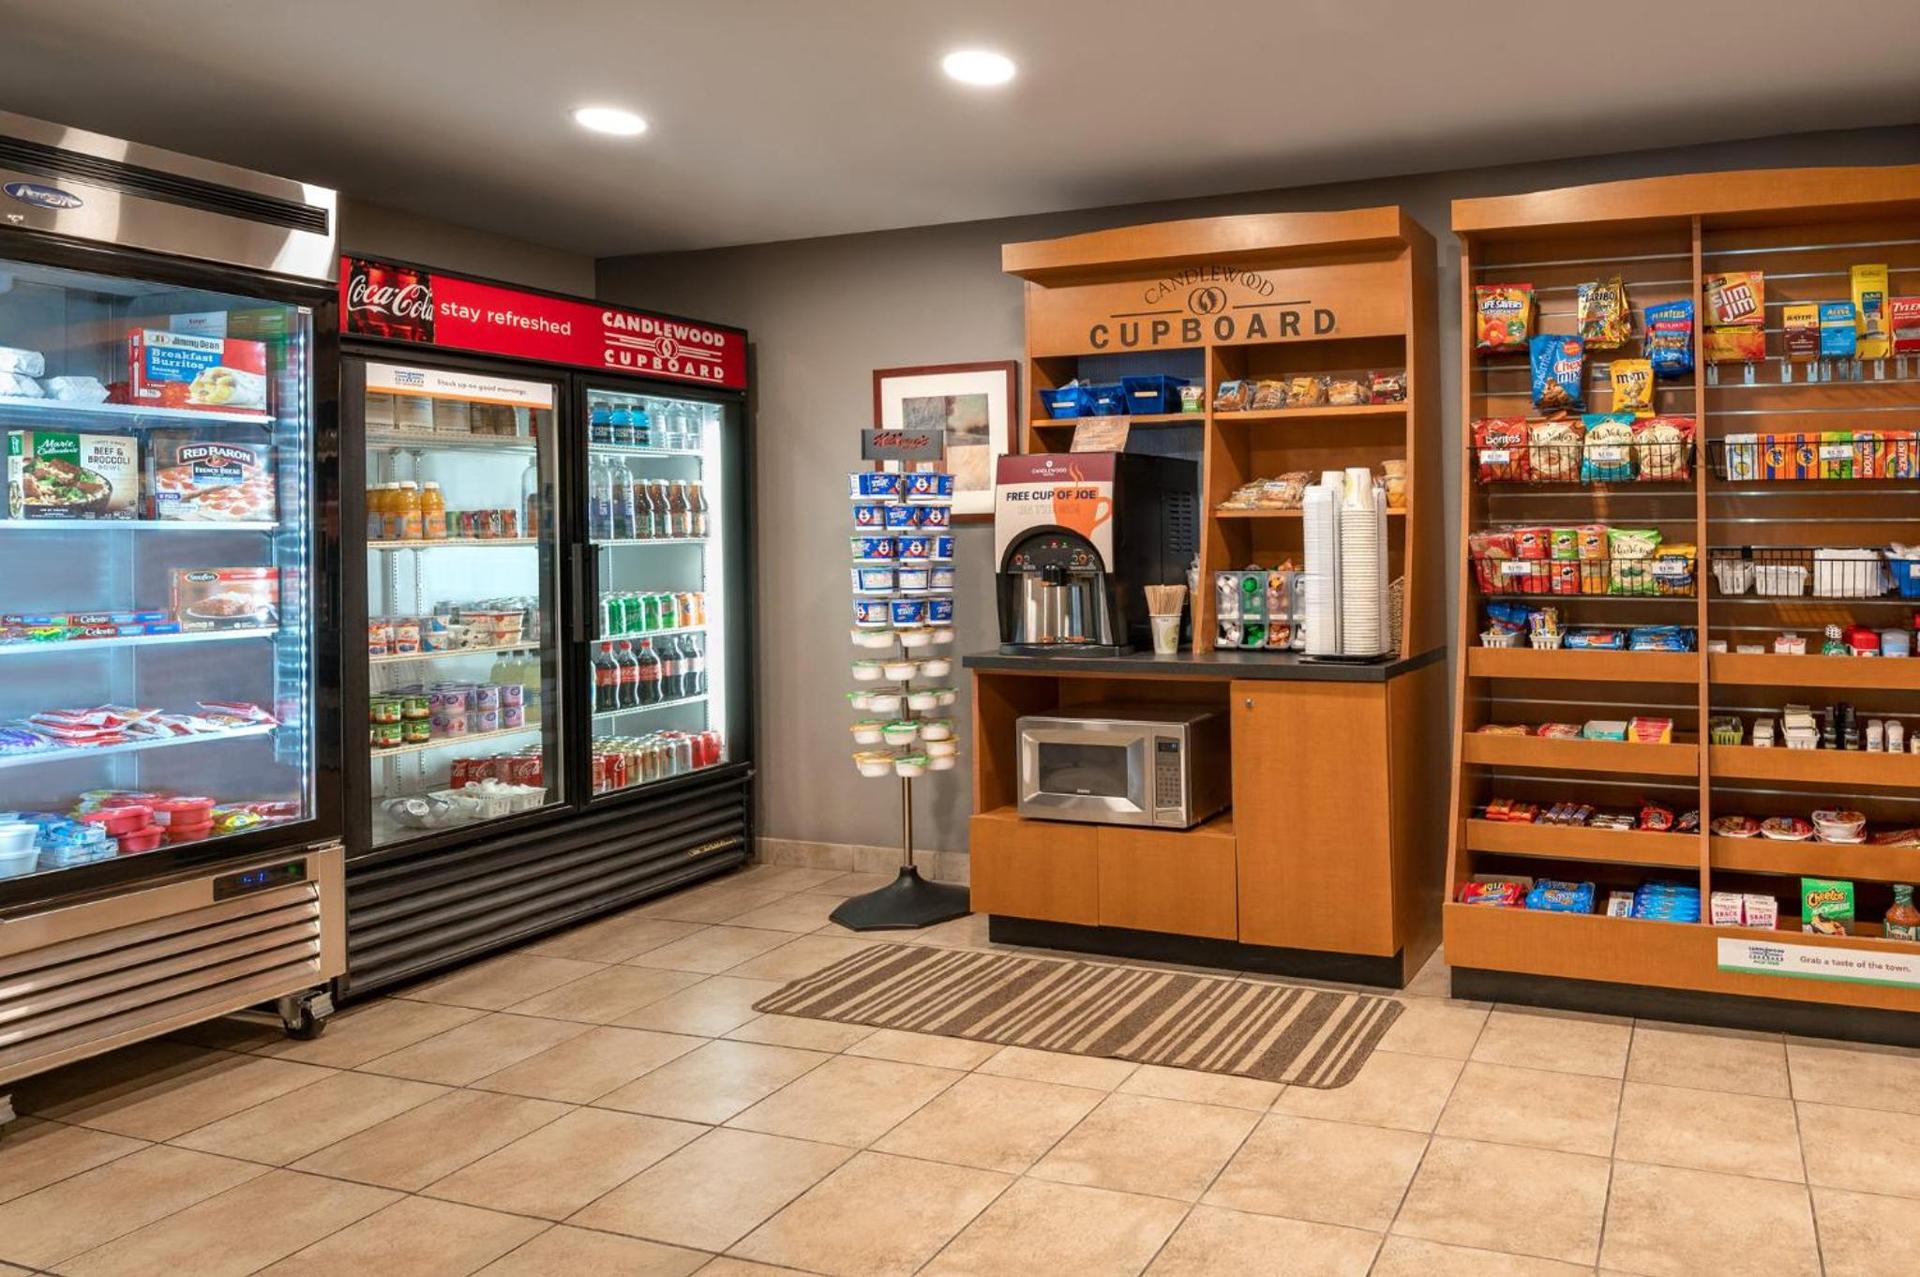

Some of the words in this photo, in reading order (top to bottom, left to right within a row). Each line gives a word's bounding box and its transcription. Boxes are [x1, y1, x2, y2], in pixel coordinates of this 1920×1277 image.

[1144, 264, 1275, 305] CANDLEWOOD
[347, 274, 434, 321] Coca-Cola
[440, 302, 481, 323] stay
[487, 311, 572, 335] refreshed
[602, 311, 725, 347] CANDLEWOOD
[1089, 308, 1336, 349] CUPBOARD
[172, 337, 198, 349] Jimmy
[200, 340, 220, 349] Dean
[152, 348, 213, 362] Breakfast
[152, 356, 204, 370] Burritos
[604, 349, 724, 379] CUPBOARD
[1486, 434, 1520, 444] Doritos
[94, 446, 114, 455] BEEF
[183, 448, 208, 459] RED
[208, 446, 251, 461] BARON
[87, 456, 130, 465] BROCCOLI
[1006, 491, 1030, 501] FREE
[1032, 490, 1055, 500] CUP
[1057, 490, 1073, 500] OF
[1075, 489, 1097, 500] JOE
[1807, 889, 1845, 907] Cheetos
[1800, 955, 1822, 965] Grab
[1832, 959, 1854, 968] taste
[1856, 961, 1866, 969] of
[1868, 962, 1882, 970] the
[1885, 964, 1911, 973] town.
